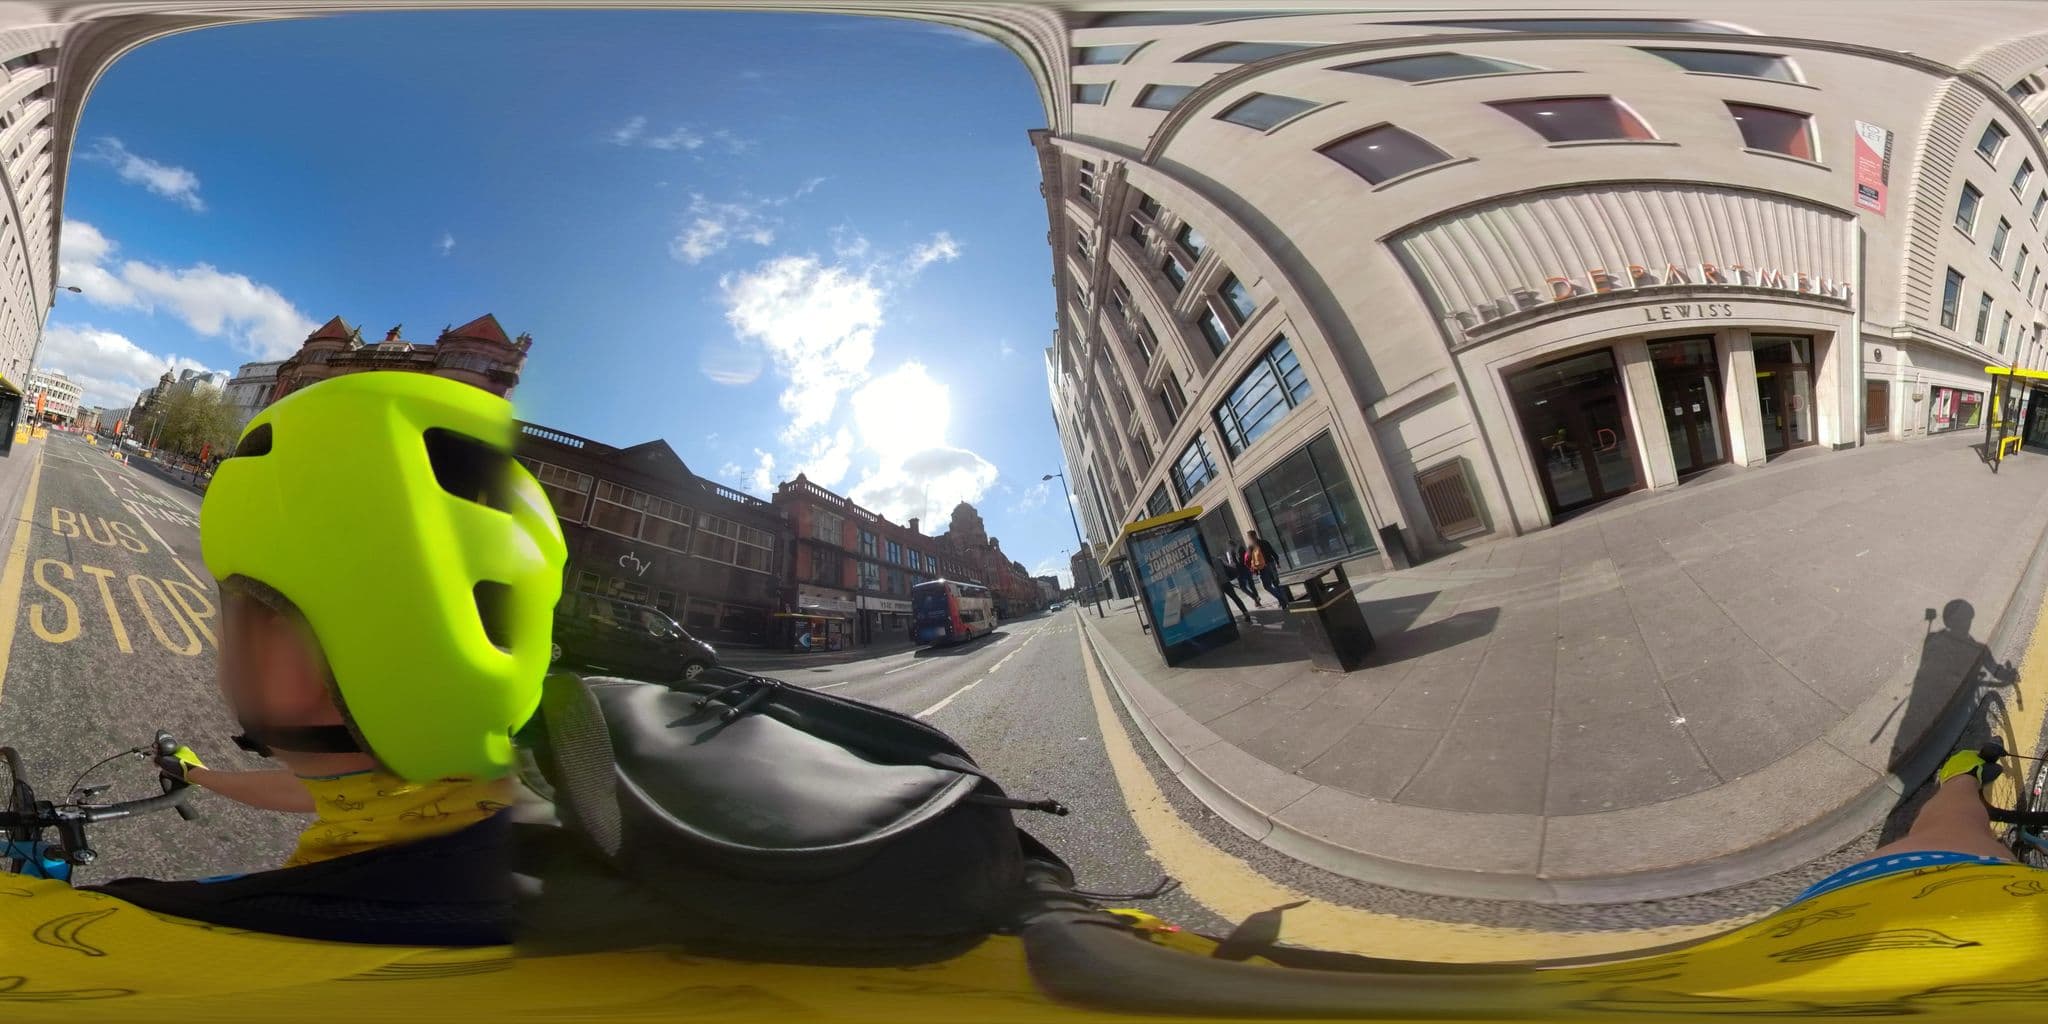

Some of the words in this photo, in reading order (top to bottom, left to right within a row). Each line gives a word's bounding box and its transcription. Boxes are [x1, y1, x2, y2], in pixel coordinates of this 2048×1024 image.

[1546, 262, 1850, 302] DEPARTMENT
[1645, 303, 1733, 322] LEWIS'S
[51, 506, 149, 553] BUS
[1148, 542, 1195, 573] JOURNEYS
[29, 558, 219, 656] STOP
